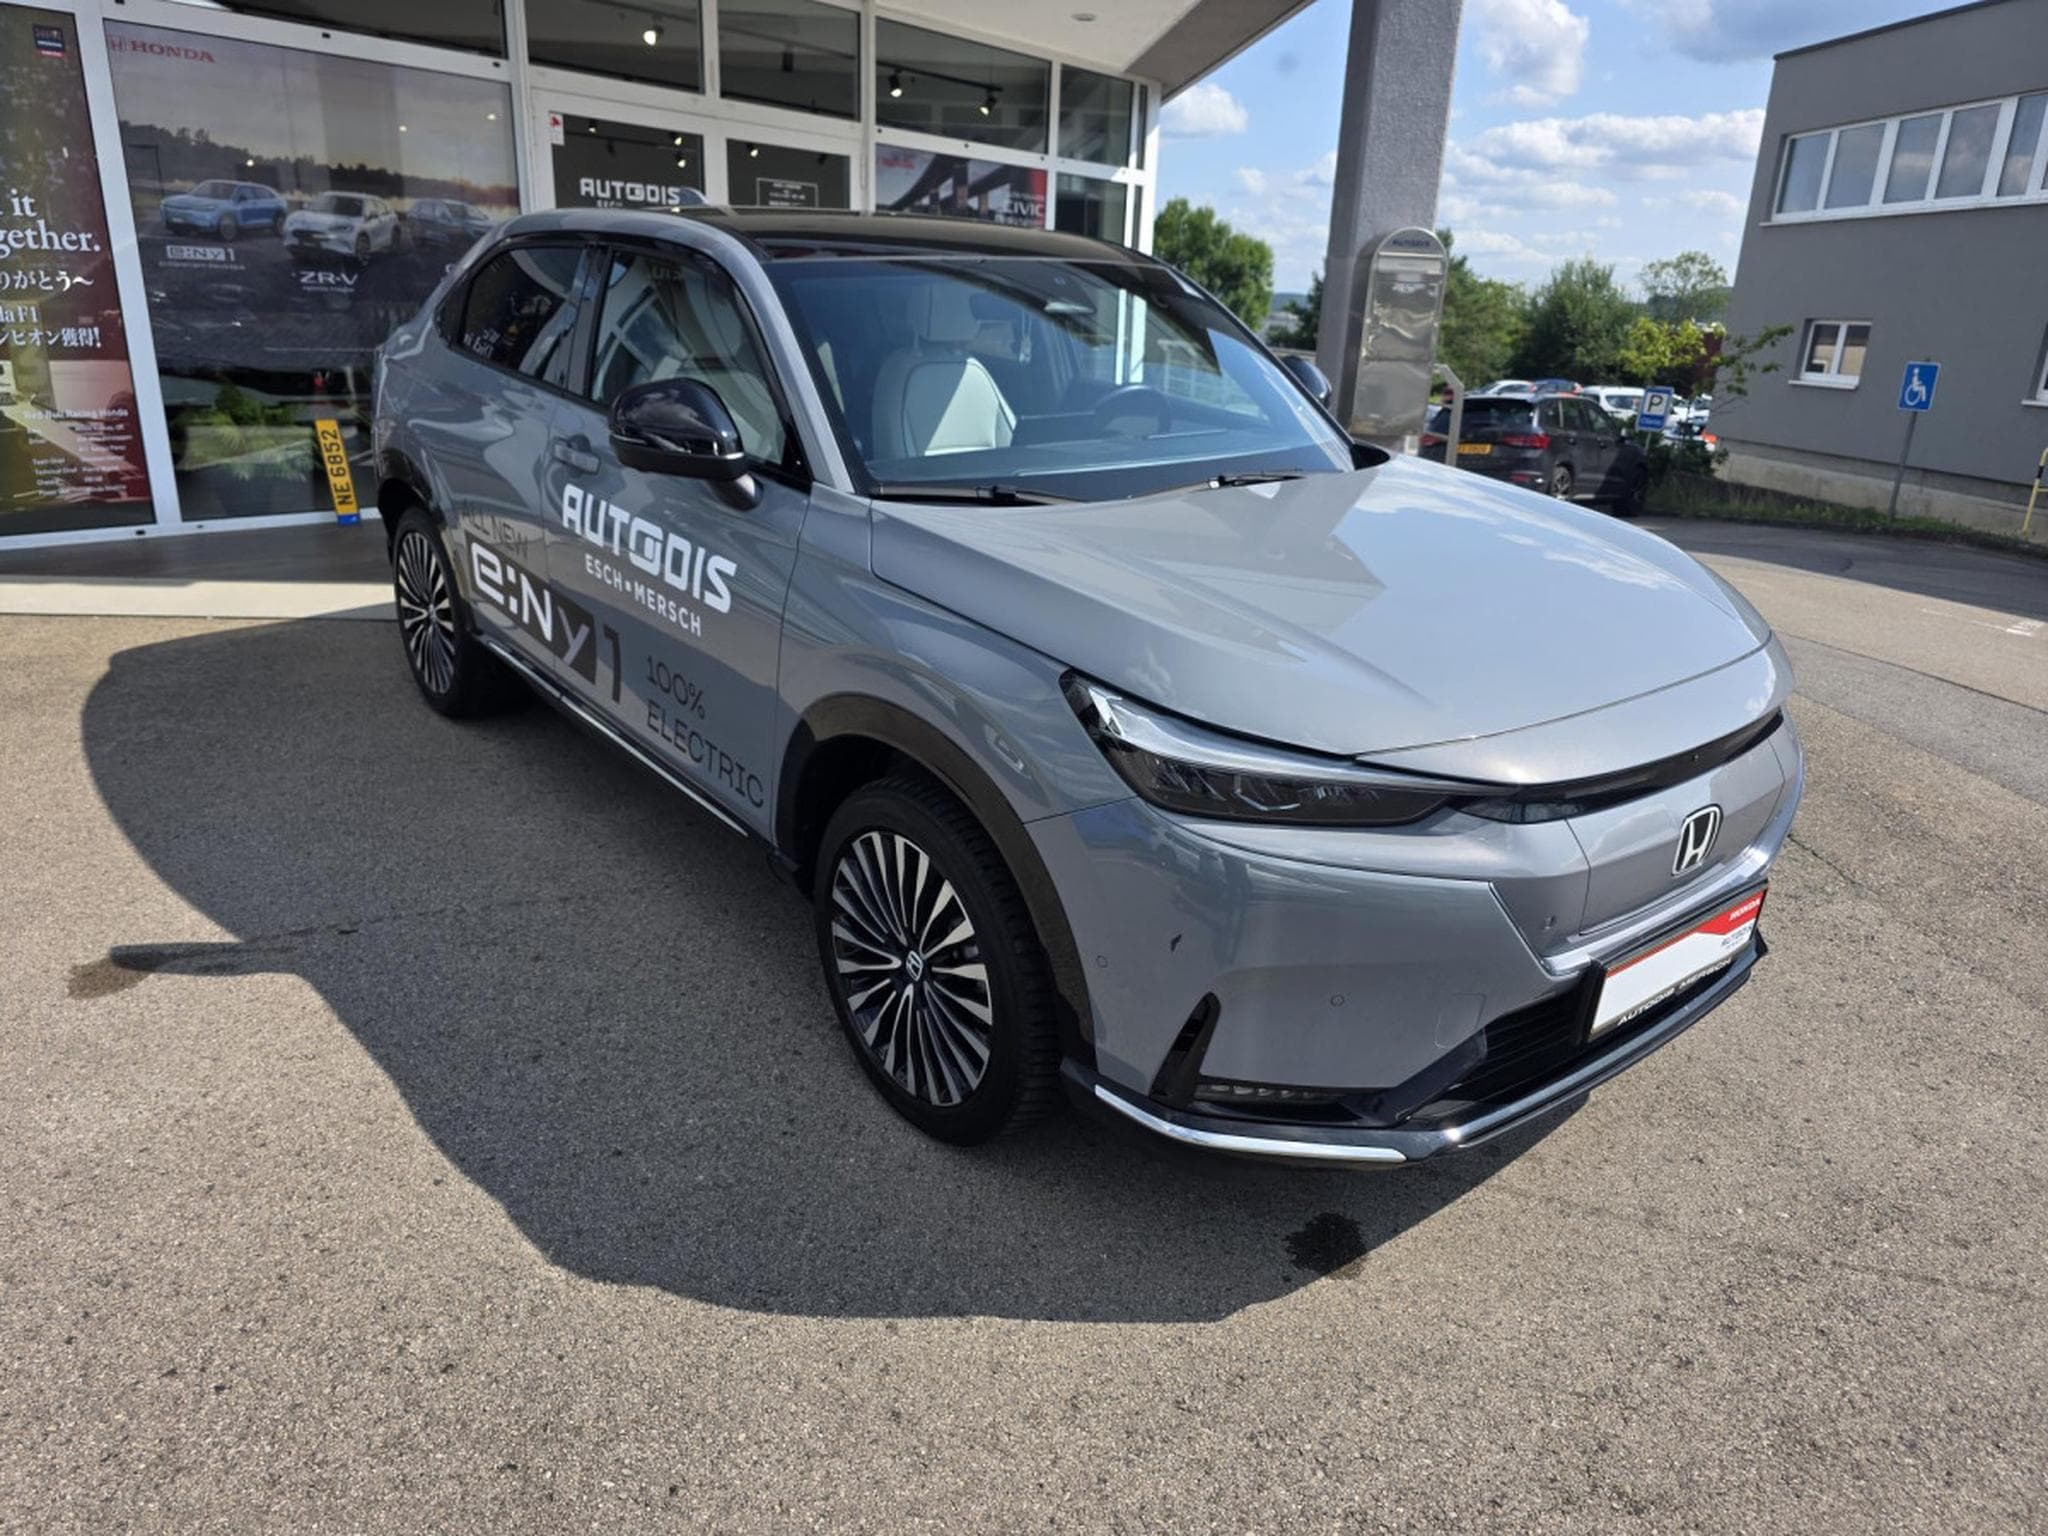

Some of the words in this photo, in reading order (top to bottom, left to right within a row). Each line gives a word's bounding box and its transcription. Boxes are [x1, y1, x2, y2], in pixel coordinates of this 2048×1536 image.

[131, 39, 215, 63] HONDA
[10, 188, 37, 217] it
[580, 177, 681, 205] AUTODIS
[321, 428, 347, 477] 6852
[335, 482, 354, 506] NE
[562, 482, 738, 614] AUTODIS
[646, 655, 706, 721] 100%
[647, 699, 764, 809] ELECTRIC
